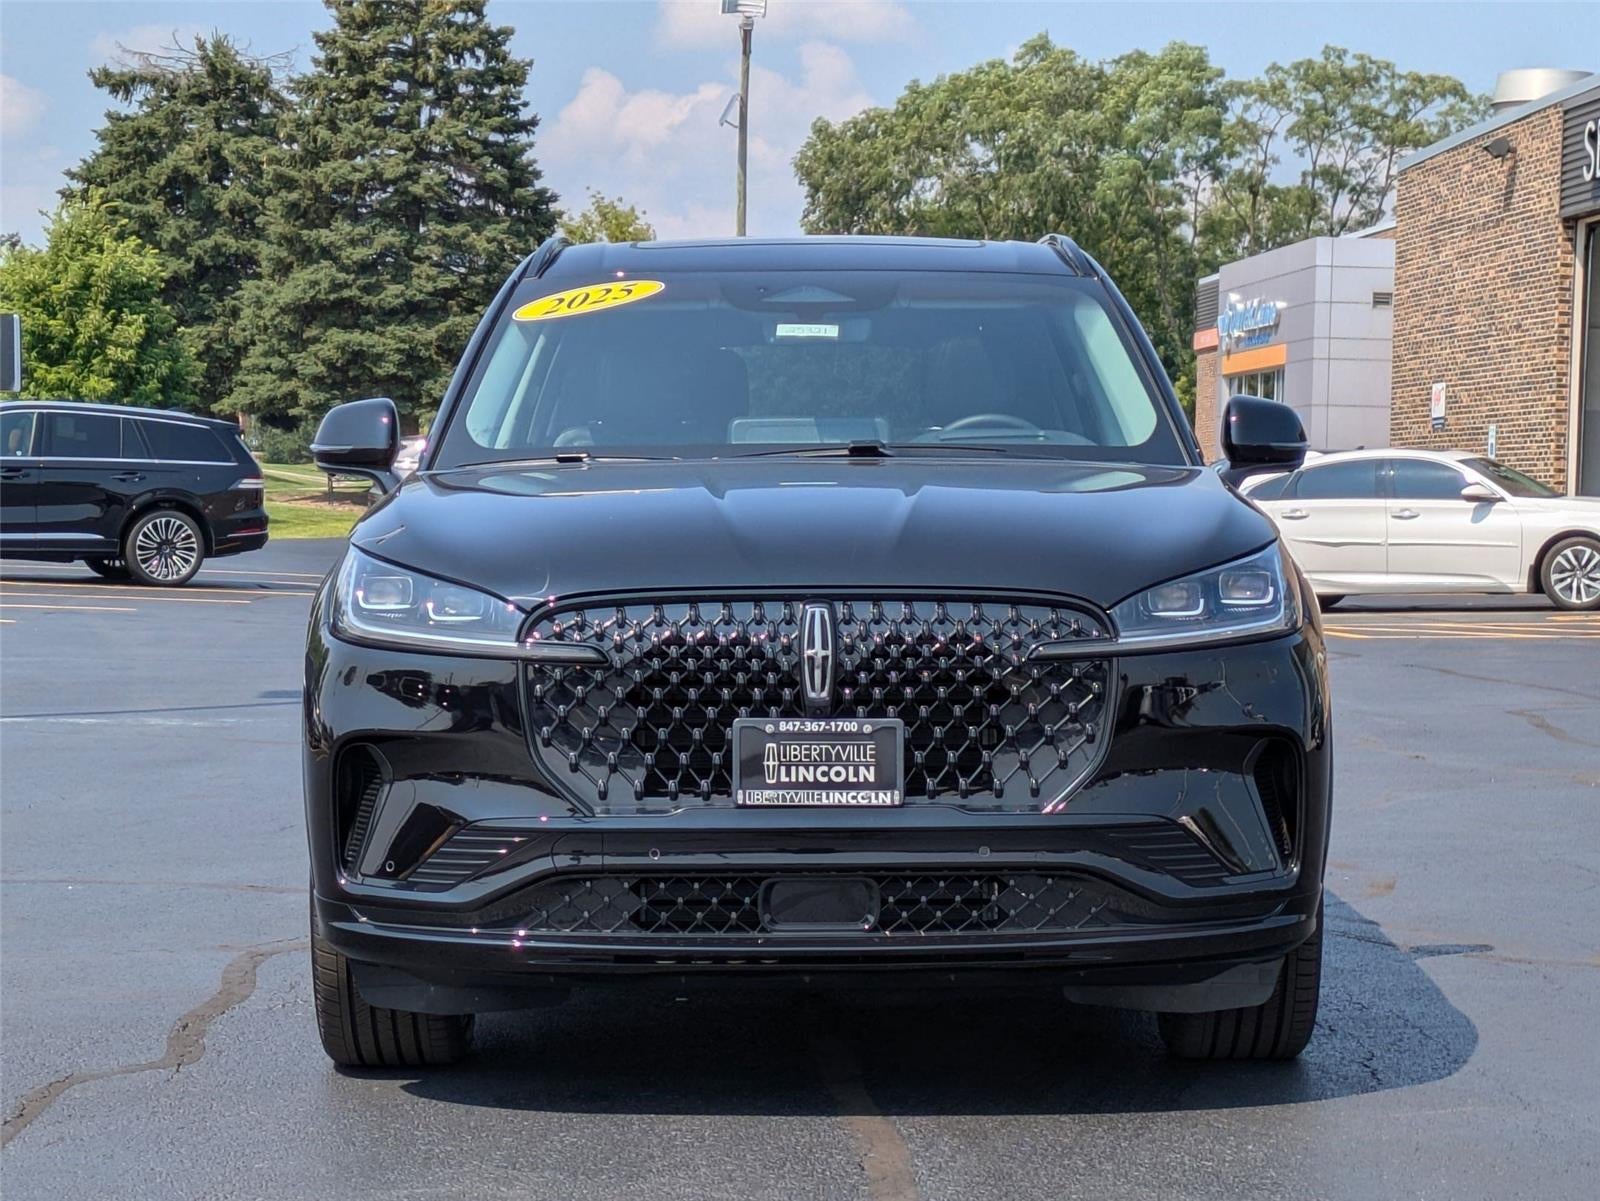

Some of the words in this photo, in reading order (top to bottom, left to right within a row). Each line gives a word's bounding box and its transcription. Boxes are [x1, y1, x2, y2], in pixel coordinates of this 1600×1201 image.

[542, 283, 638, 315] 2025
[779, 721, 858, 732] 847-367-1700
[780, 744, 876, 762] LIBERTYVILLE
[780, 765, 875, 783] LINCOLN
